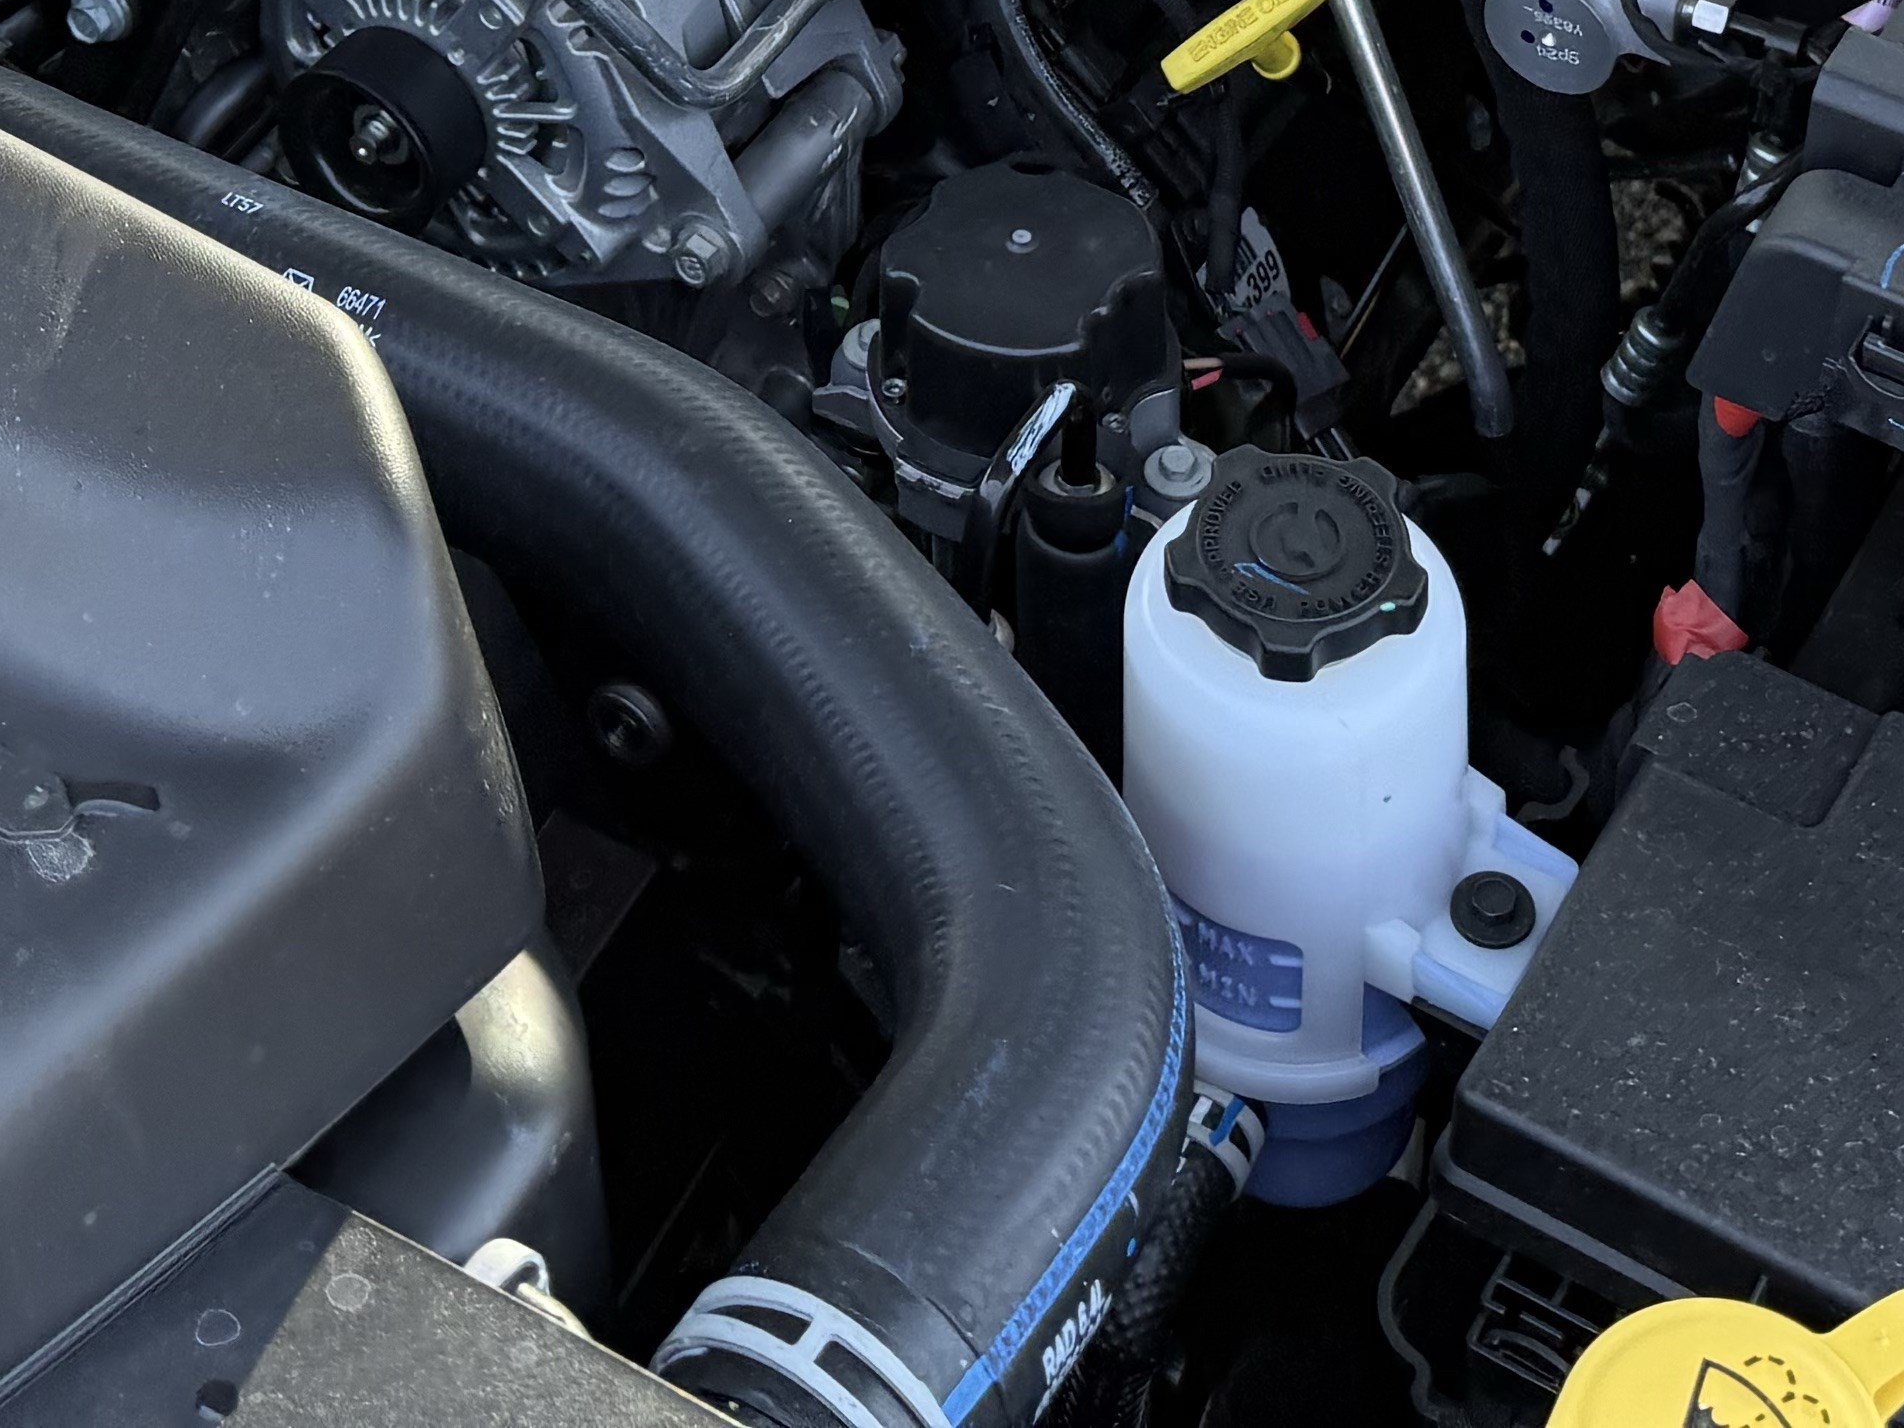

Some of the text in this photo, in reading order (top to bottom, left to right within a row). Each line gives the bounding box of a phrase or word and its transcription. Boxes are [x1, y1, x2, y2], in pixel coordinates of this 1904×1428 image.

[335, 285, 387, 321] 66471
[1198, 921, 1254, 966] MAX
[1199, 962, 1257, 1007] MIN
[1041, 1317, 1078, 1387] RAD
